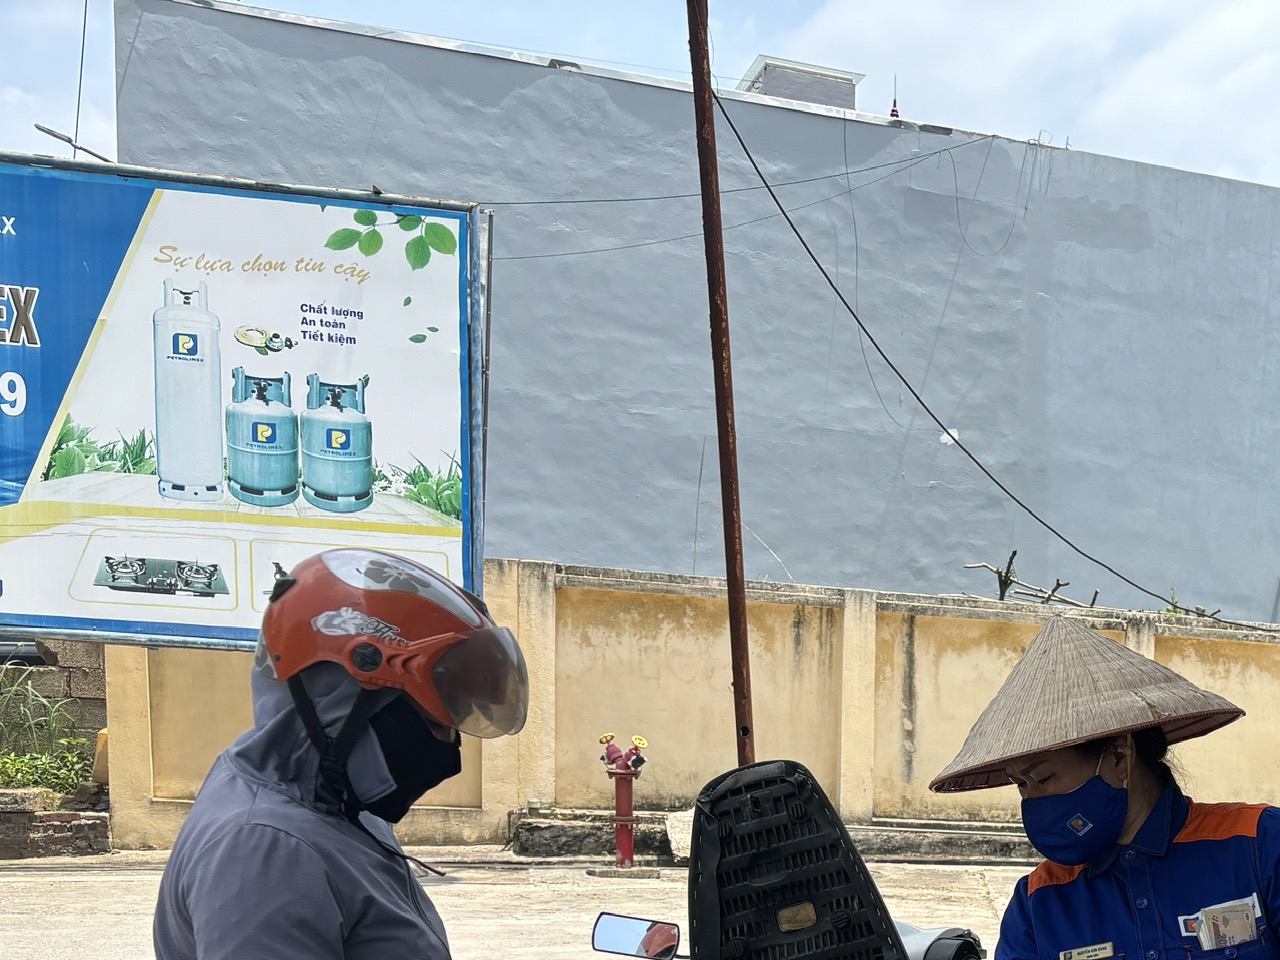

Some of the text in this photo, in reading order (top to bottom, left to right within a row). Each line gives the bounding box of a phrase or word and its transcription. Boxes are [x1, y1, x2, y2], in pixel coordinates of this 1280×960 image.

[153, 245, 371, 285] Sự lựa chọn tin cậy
[300, 299, 364, 320] Chất lượng
[300, 317, 346, 330] An toàn
[300, 329, 357, 346] Tiết kiệm
